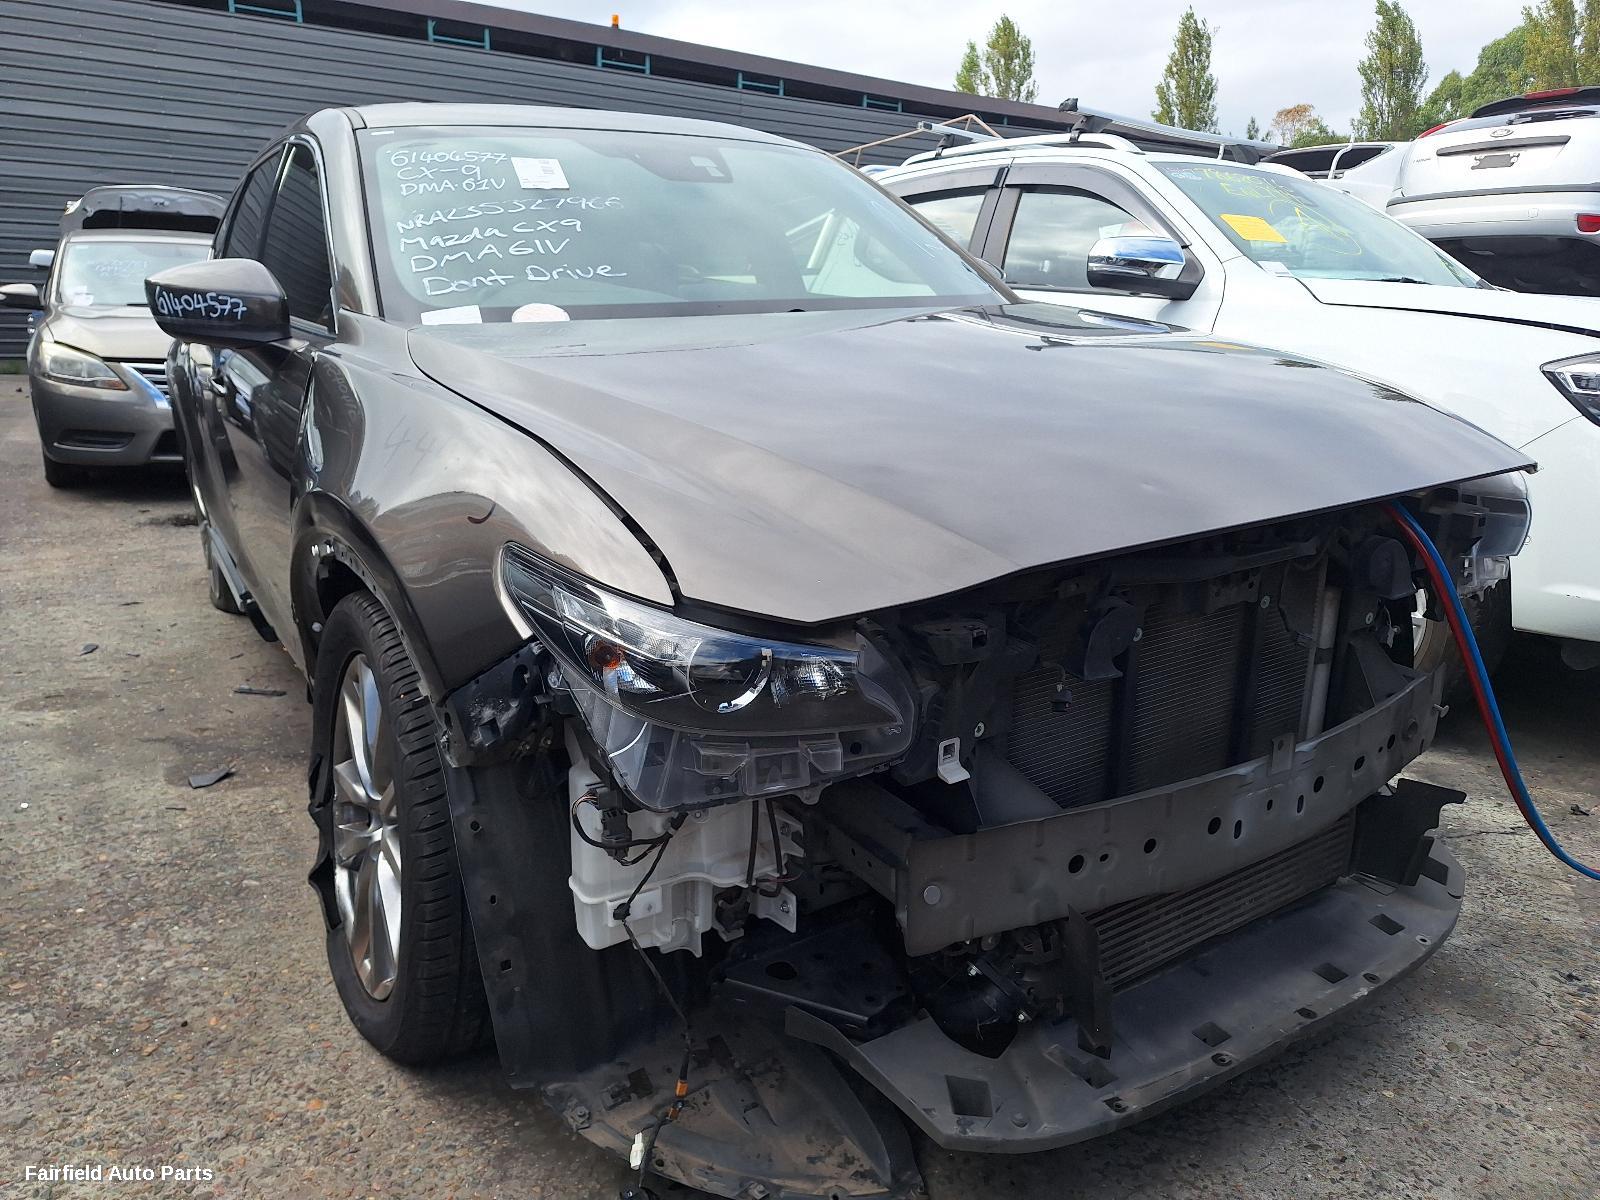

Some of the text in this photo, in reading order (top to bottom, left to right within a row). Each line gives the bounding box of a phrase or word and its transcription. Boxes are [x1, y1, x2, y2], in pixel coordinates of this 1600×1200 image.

[399, 218, 582, 252] Mazda CX9
[411, 244, 503, 273] DMA
[525, 264, 628, 282] Drive
[154, 286, 247, 320] 61404577
